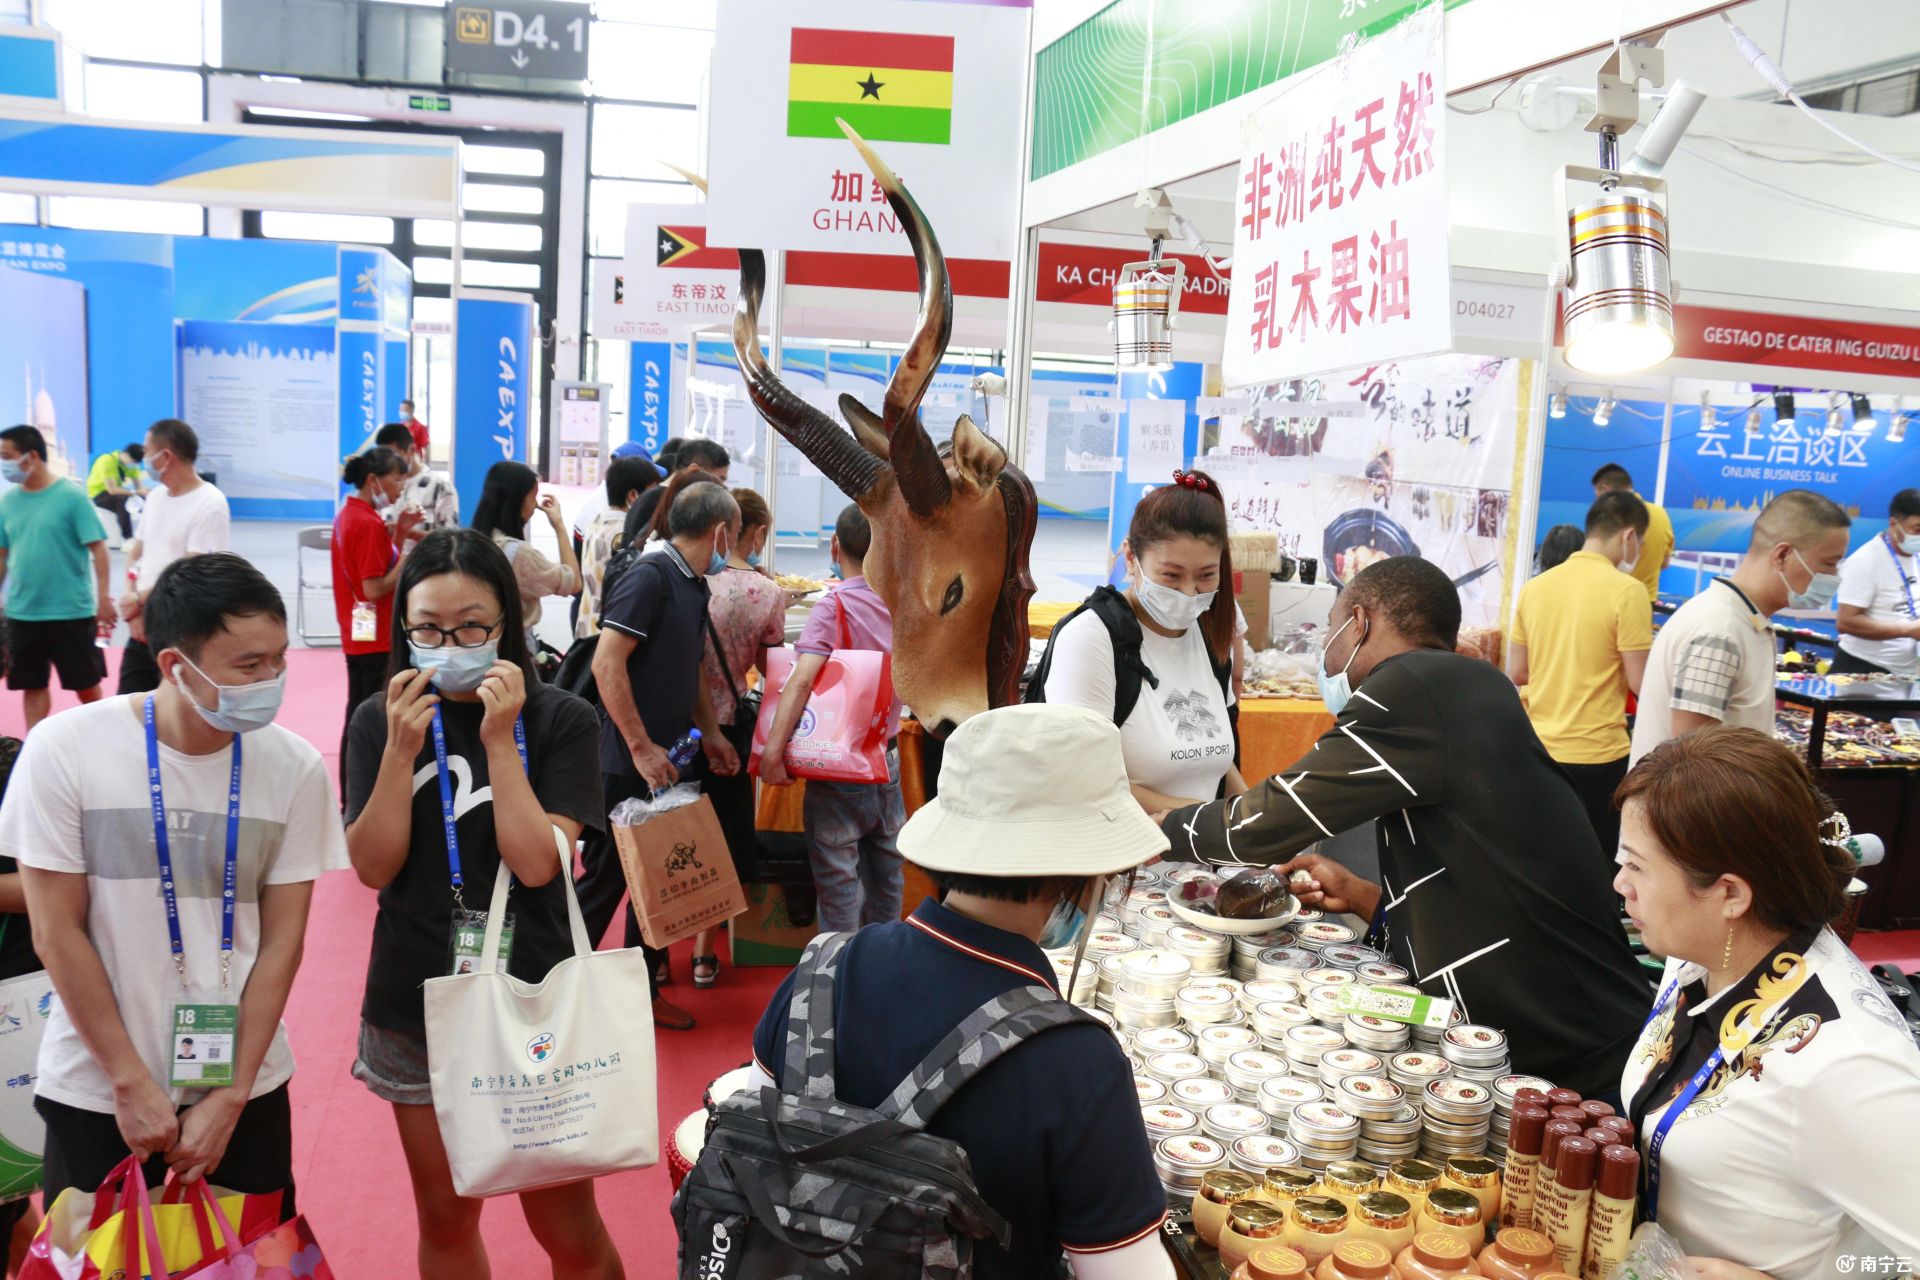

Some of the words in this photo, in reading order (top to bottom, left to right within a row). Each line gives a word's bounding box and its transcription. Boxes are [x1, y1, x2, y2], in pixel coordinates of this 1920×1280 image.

[493, 10, 583, 52] D4.1
[1242, 71, 1435, 241] 非洲纯天然
[813, 208, 906, 233] GHAN
[1056, 265, 1083, 285] KA
[671, 283, 726, 300] 东帝汶
[1251, 219, 1411, 354] 乳木果油
[657, 301, 690, 313] EAST
[1456, 300, 1515, 319] D04027
[1703, 326, 1763, 347] GESTAO
[1765, 332, 1785, 349] DE
[1787, 334, 1832, 354] CATER
[1835, 340, 1862, 356] ING
[1865, 341, 1910, 361] GUIZU
[360, 350, 376, 432] CAEXPO
[641, 360, 660, 450] CAEXPO
[1695, 421, 1873, 467] 云上洽谈区
[1721, 465, 1761, 479] ONLINE
[1763, 467, 1812, 482] BUSINESS
[1814, 470, 1838, 484] TALK
[1170, 748, 1202, 760] KOLON
[1205, 744, 1230, 756] SPORT
[459, 933, 475, 947] 18
[176, 1009, 196, 1024] 18
